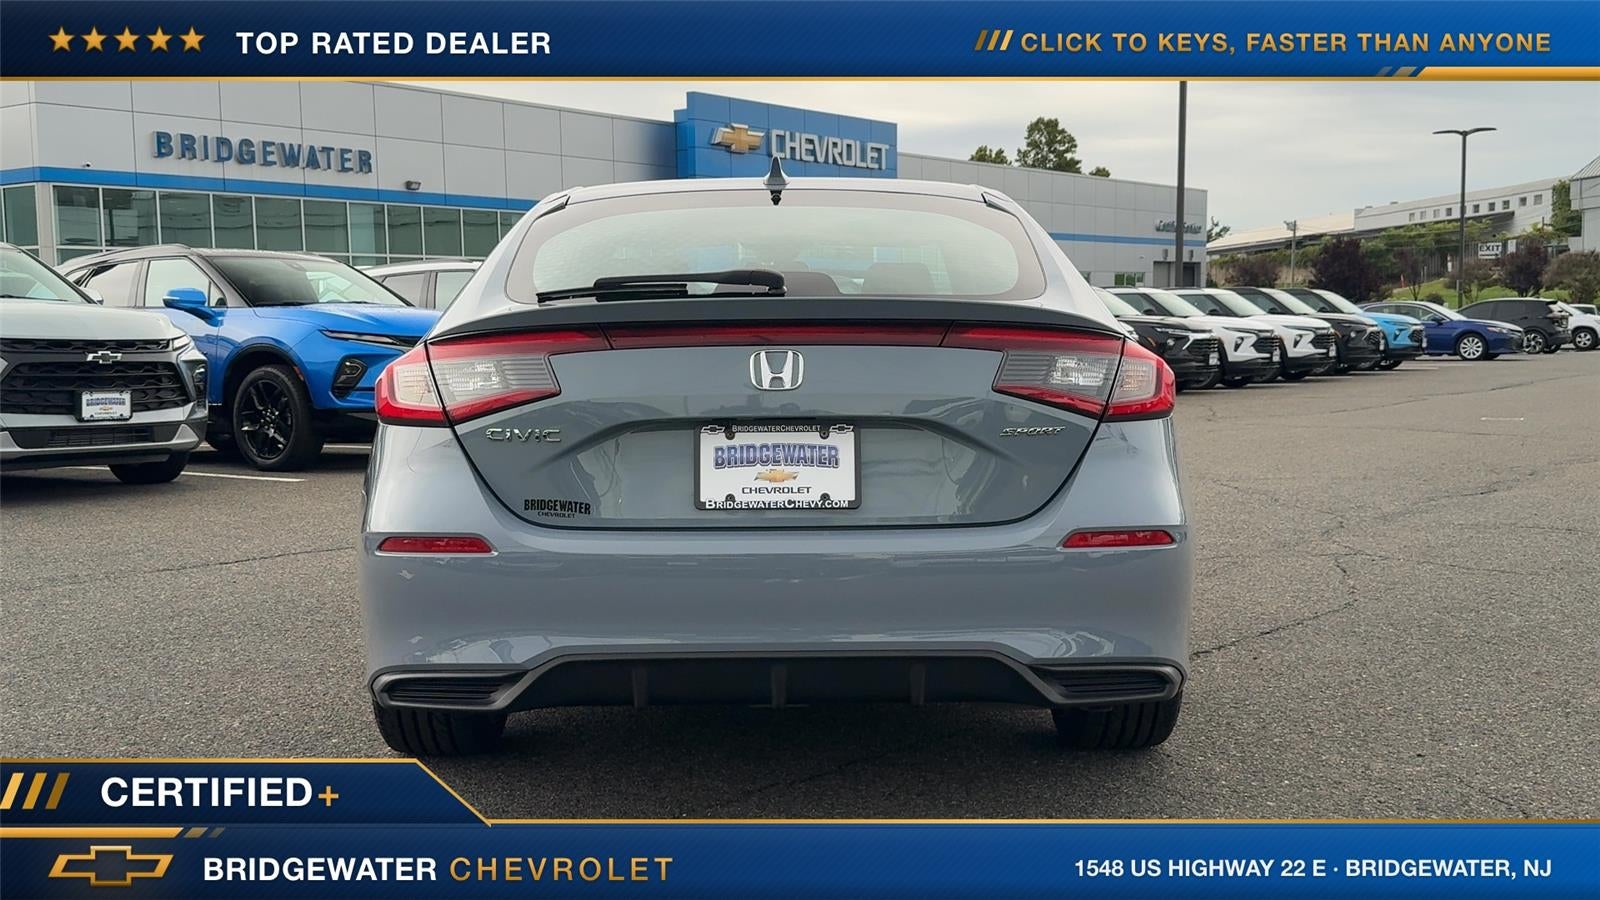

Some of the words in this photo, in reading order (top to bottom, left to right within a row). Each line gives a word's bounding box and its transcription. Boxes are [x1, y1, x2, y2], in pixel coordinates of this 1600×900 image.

[153, 131, 372, 174] BRIDGEWATER
[771, 129, 889, 170] CHEVROLET
[1479, 244, 1500, 252] EXIT
[485, 428, 561, 442] CIVIC
[1000, 425, 1067, 437] SPORT
[713, 442, 840, 470] BRIDGEWATER
[741, 486, 813, 495] CHEVROLET
[523, 498, 591, 515] BRIDGEWATER
[537, 511, 576, 519] CHEVROLET
